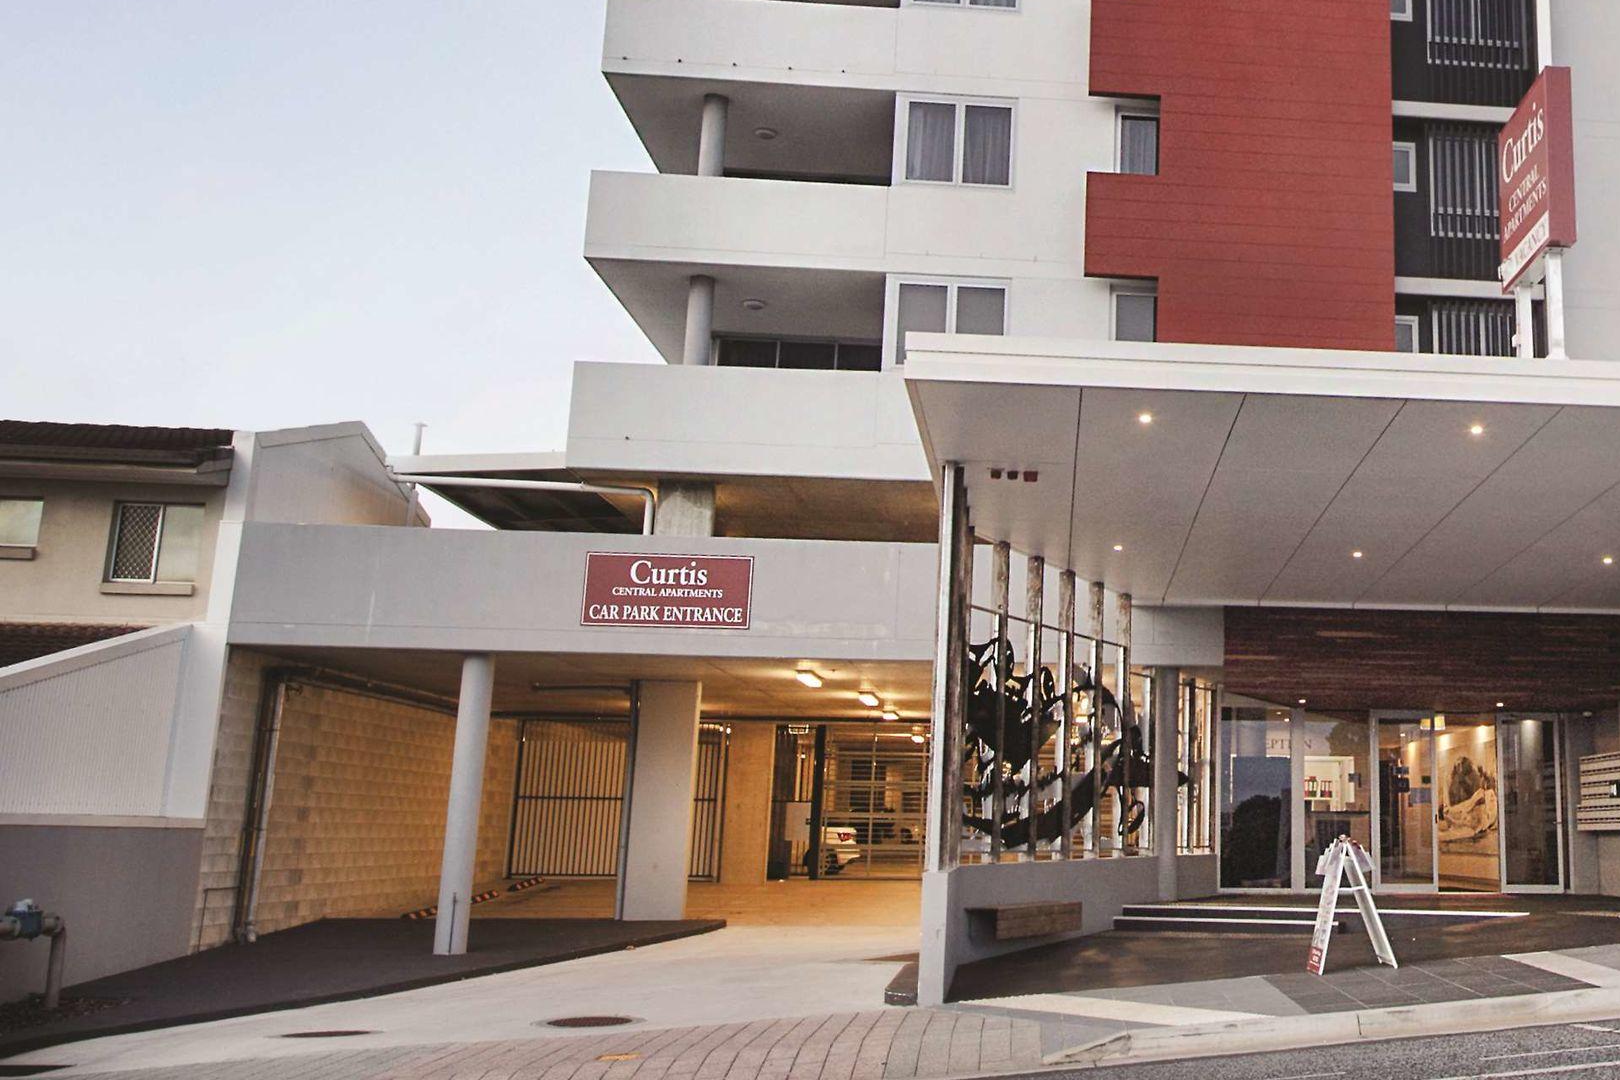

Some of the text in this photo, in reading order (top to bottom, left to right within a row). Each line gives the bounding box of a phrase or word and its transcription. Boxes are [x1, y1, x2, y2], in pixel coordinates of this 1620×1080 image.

[1502, 102, 1545, 184] Curtis
[1508, 165, 1539, 213] CENTRAL
[1503, 177, 1548, 244] APARTMENTS
[630, 560, 708, 586] Curtis
[612, 586, 723, 598] CENTRAL APARTMENTS
[589, 604, 743, 623] CAR PARK ENTRANCE
